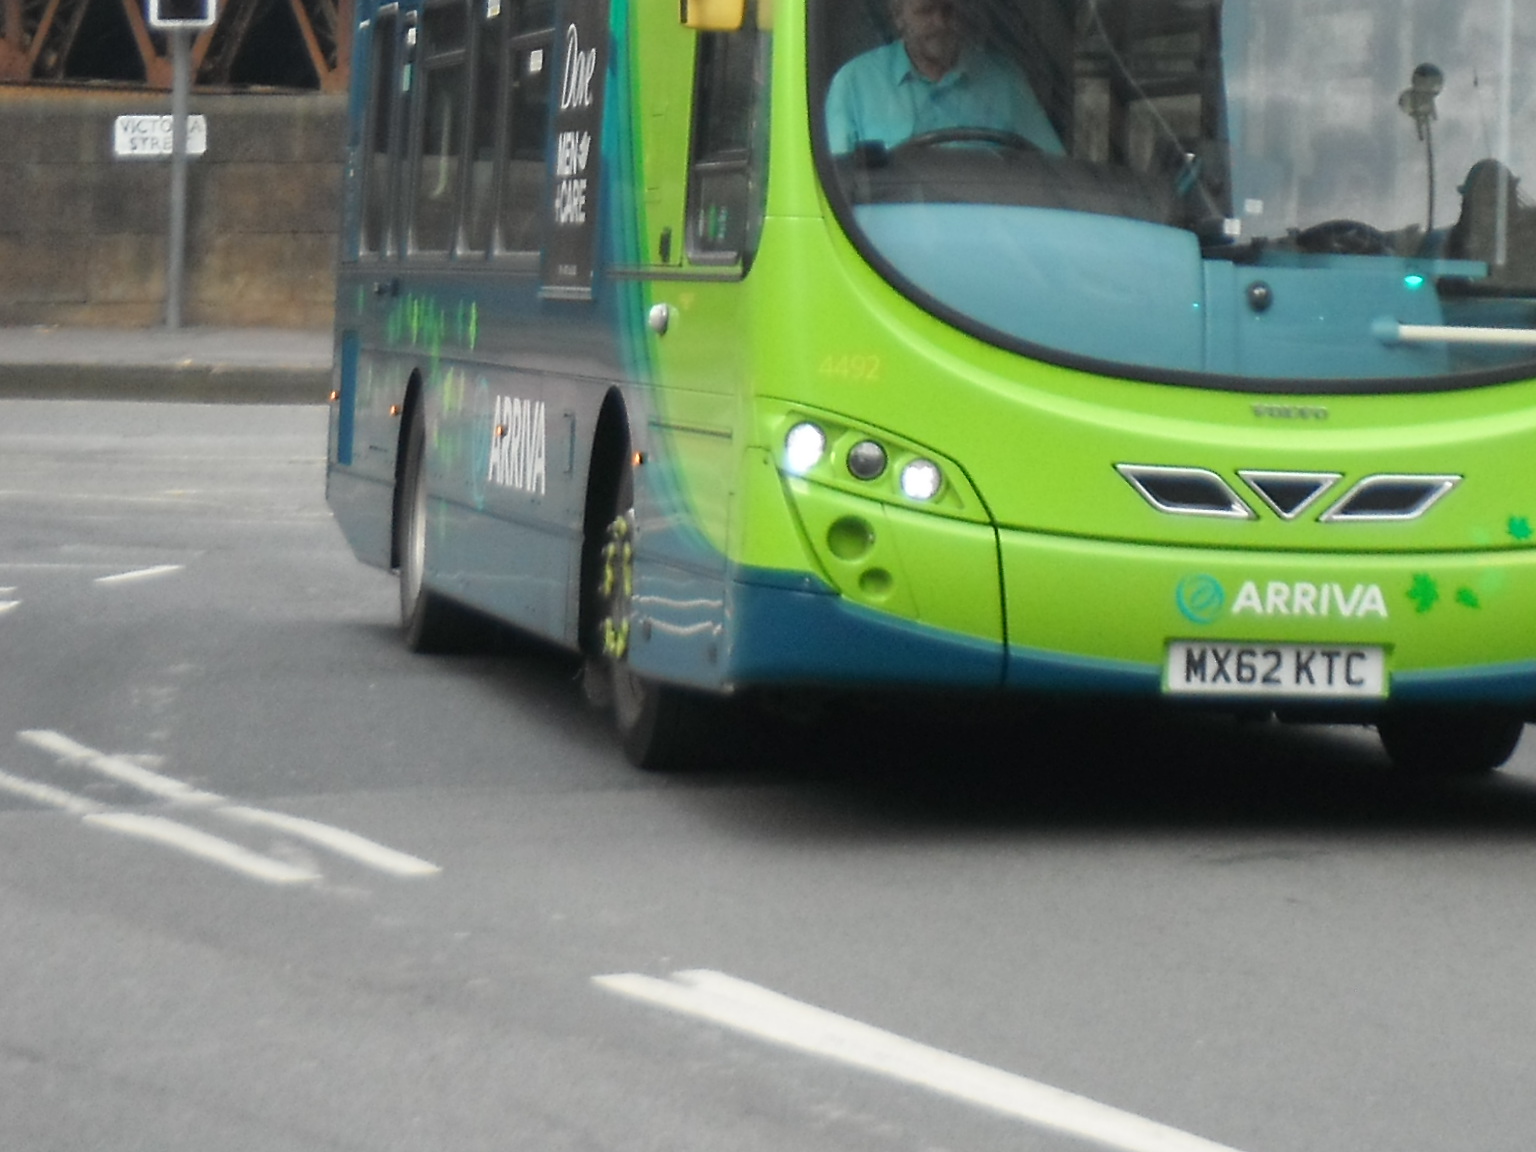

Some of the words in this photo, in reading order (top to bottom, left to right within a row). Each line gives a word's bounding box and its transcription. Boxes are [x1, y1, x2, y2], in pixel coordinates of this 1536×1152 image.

[119, 118, 204, 134] VICTOA
[818, 355, 881, 379] 4492
[488, 394, 546, 496] ARRIVA
[1231, 580, 1389, 618] ARRIVA
[1184, 648, 1282, 685] MX62
[1294, 651, 1366, 686] KTC
